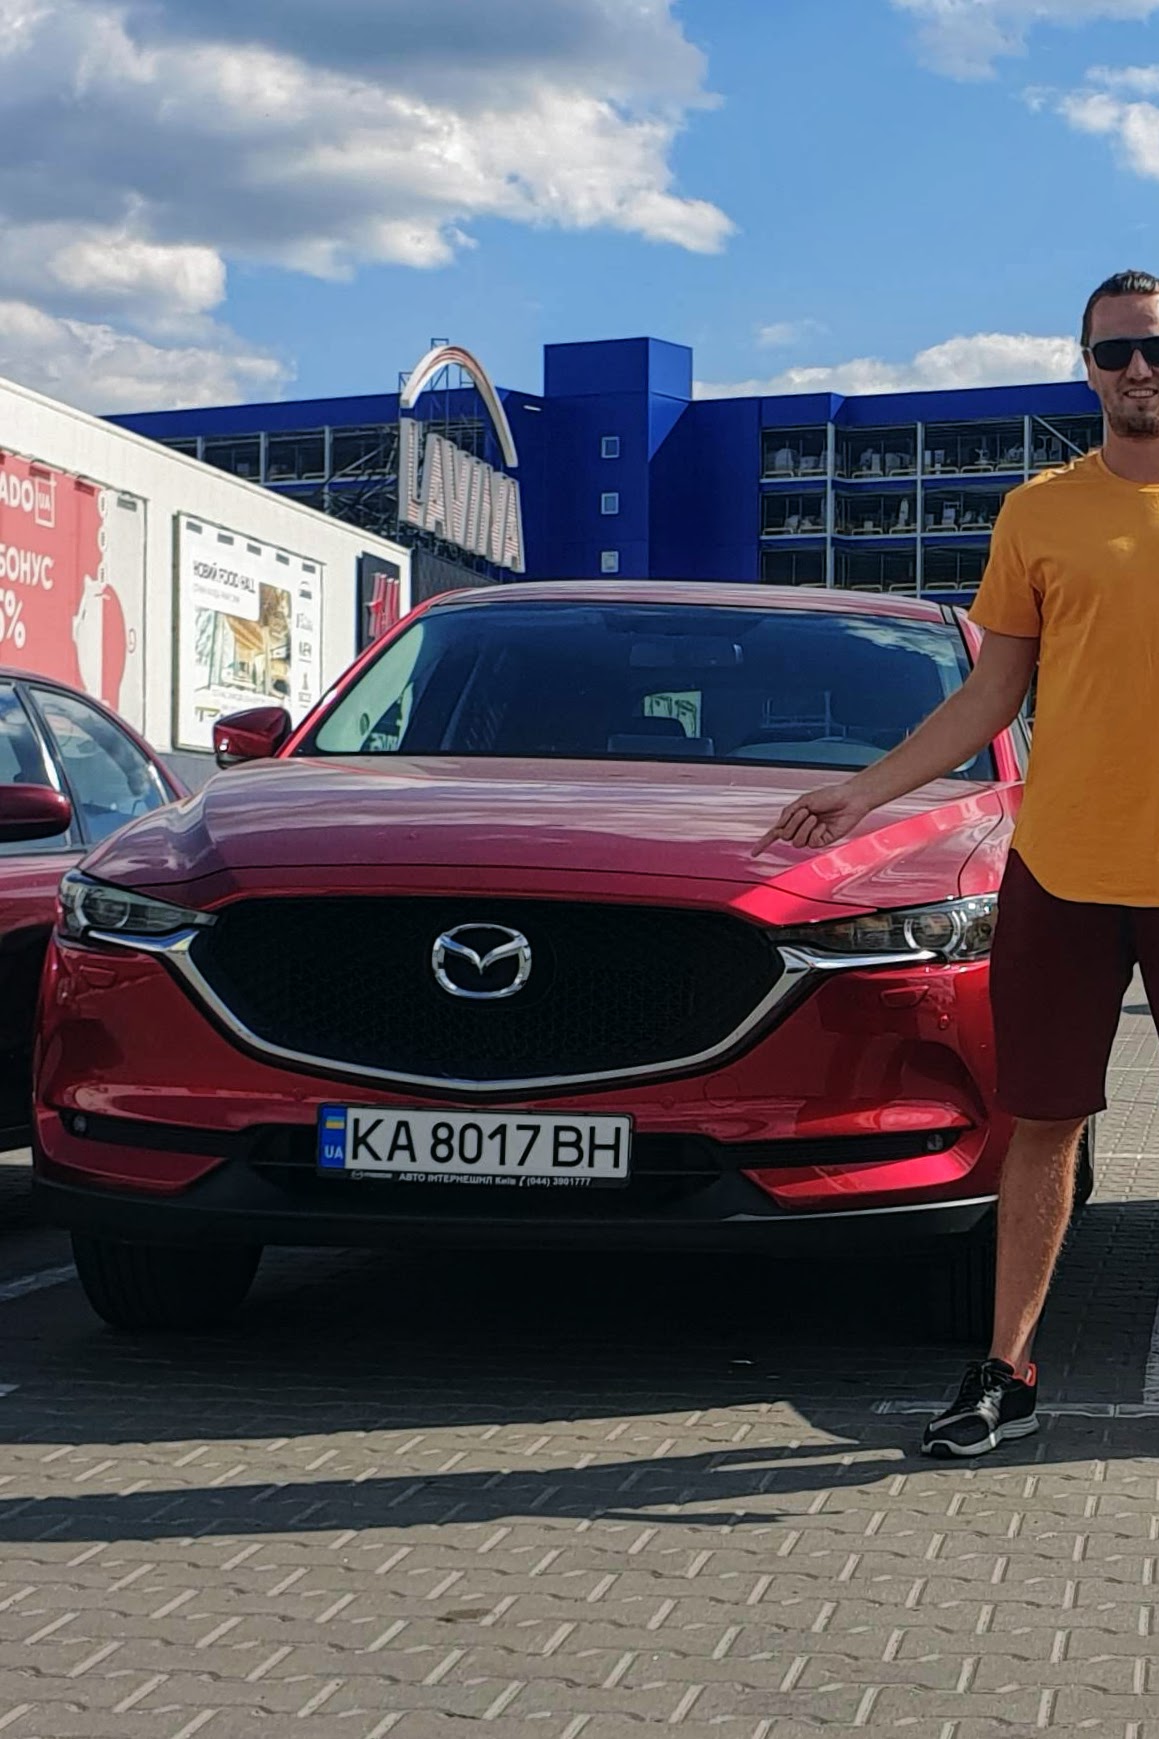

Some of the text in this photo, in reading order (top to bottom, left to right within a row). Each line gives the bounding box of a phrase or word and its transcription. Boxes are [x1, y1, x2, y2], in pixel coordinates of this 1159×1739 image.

[398, 416, 526, 573] LAVINA
[324, 1145, 344, 1160] UA
[351, 1117, 622, 1169] KA 8017 BH
[399, 1172, 426, 1182] АВТО
[526, 1176, 551, 1187] (044)
